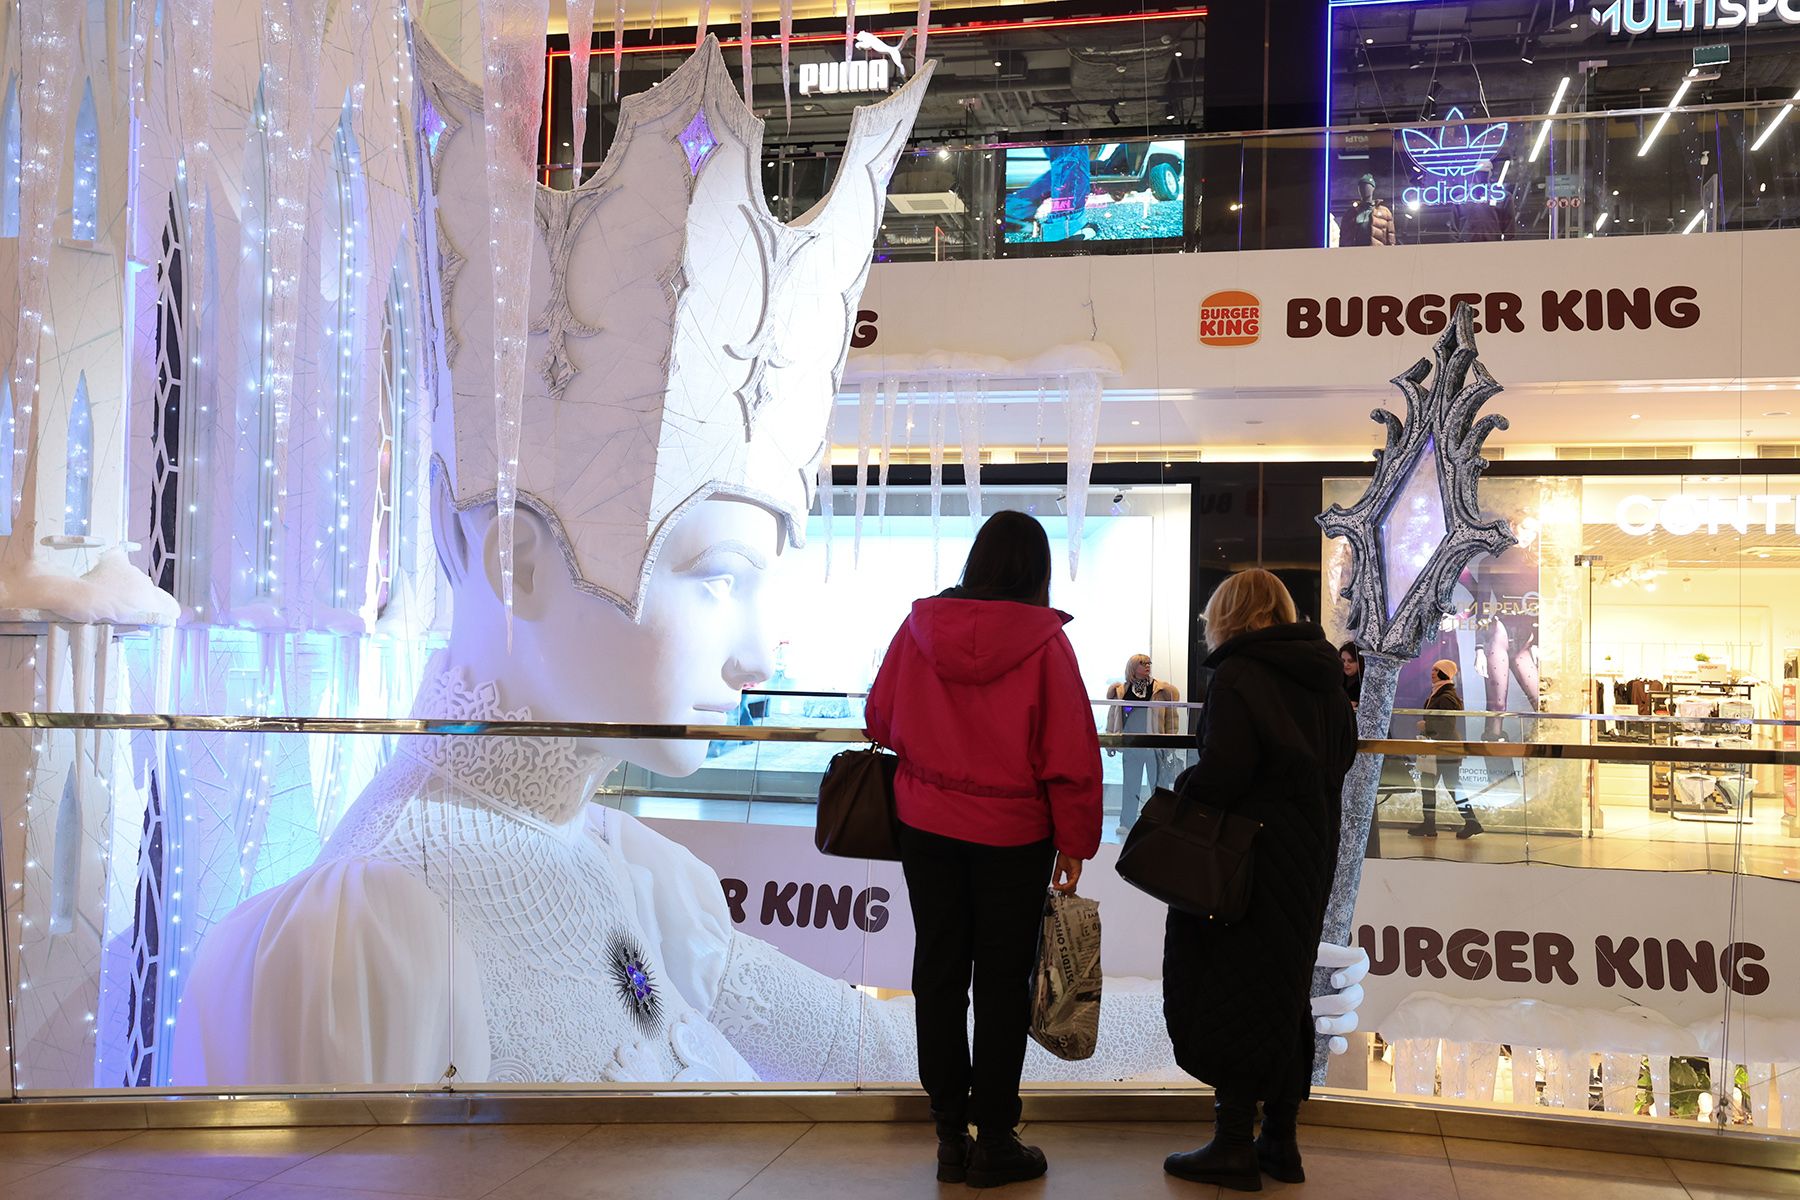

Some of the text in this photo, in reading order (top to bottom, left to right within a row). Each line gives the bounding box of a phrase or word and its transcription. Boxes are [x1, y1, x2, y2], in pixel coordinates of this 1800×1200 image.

[1590, 0, 1800, 35] MULTISP
[799, 59, 889, 95] PUMA
[1402, 179, 1506, 206] adidas
[1201, 307, 1259, 320] BURGER
[1541, 285, 1701, 332] KING
[1200, 319, 1259, 336] KING
[1615, 494, 1800, 536] CONT
[760, 880, 890, 933] KING
[1347, 924, 1770, 995] URGER KING
